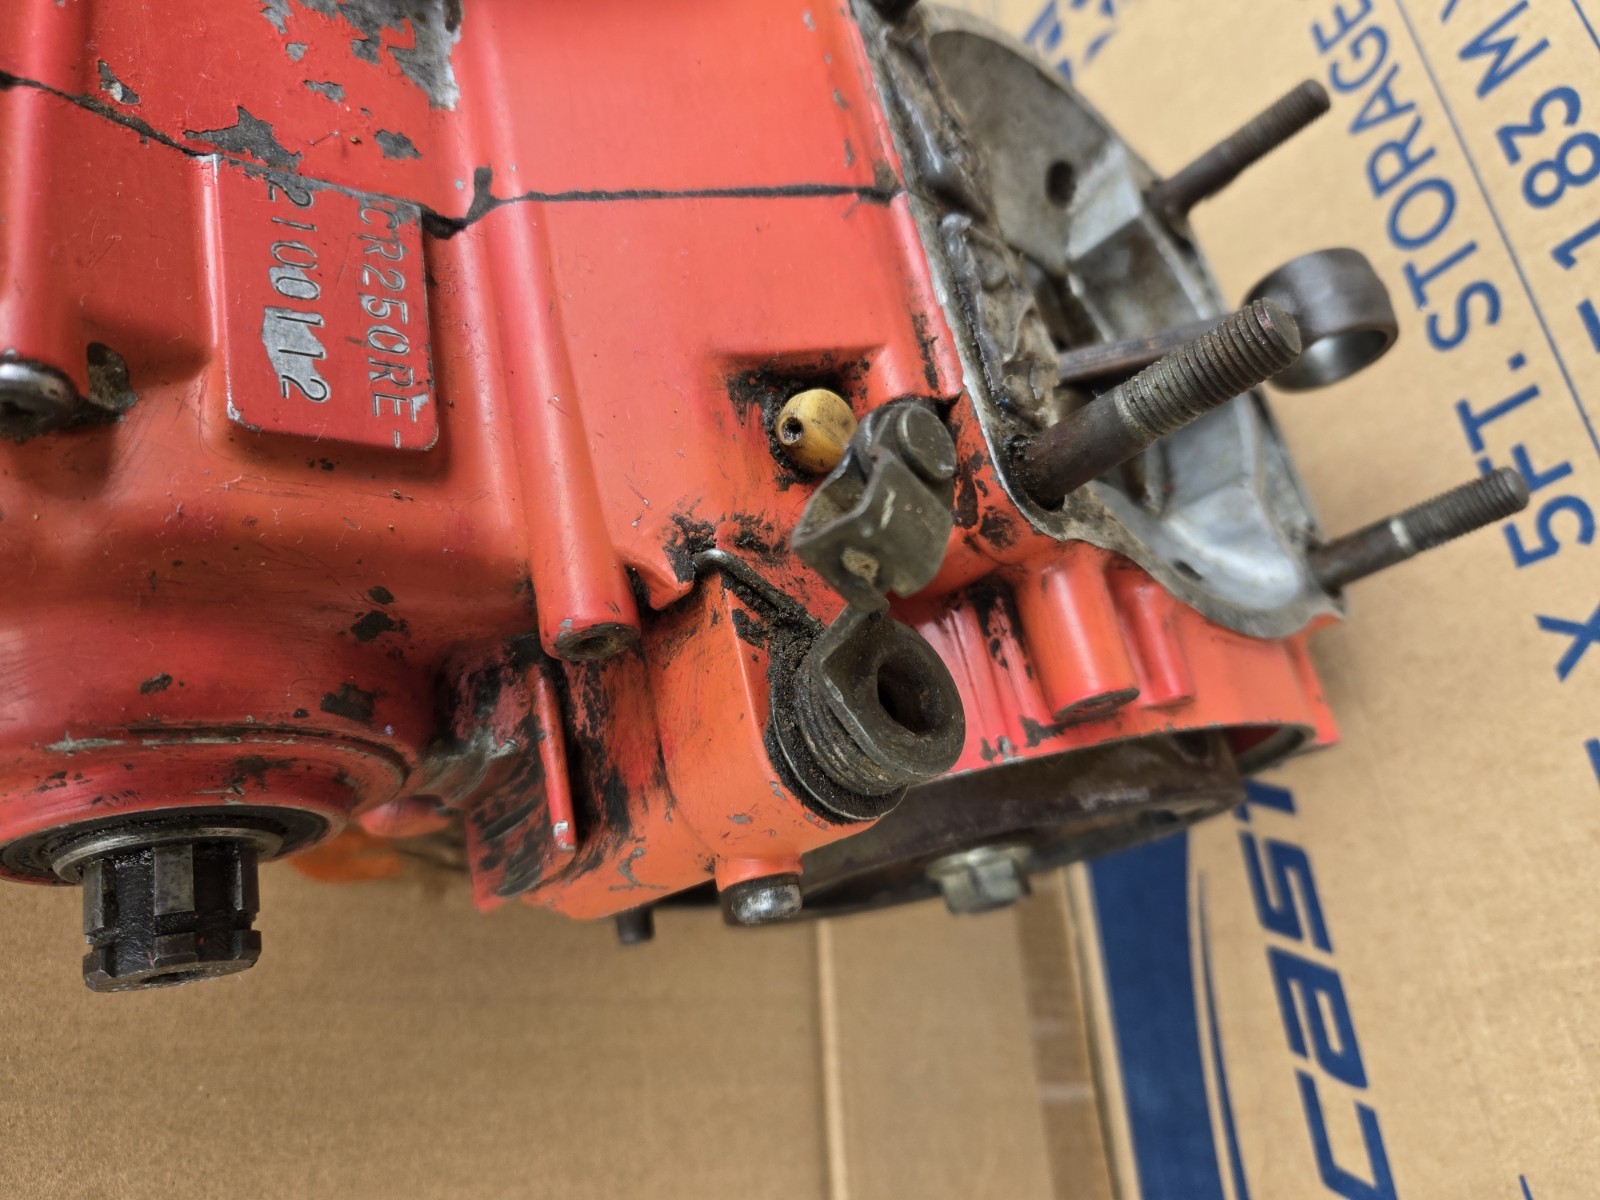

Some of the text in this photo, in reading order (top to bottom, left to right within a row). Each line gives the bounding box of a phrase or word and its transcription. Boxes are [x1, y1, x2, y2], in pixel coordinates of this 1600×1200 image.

[1458, 0, 1550, 99] M
[1311, 0, 1501, 351] STORAGE
[268, 179, 331, 403] 2100112
